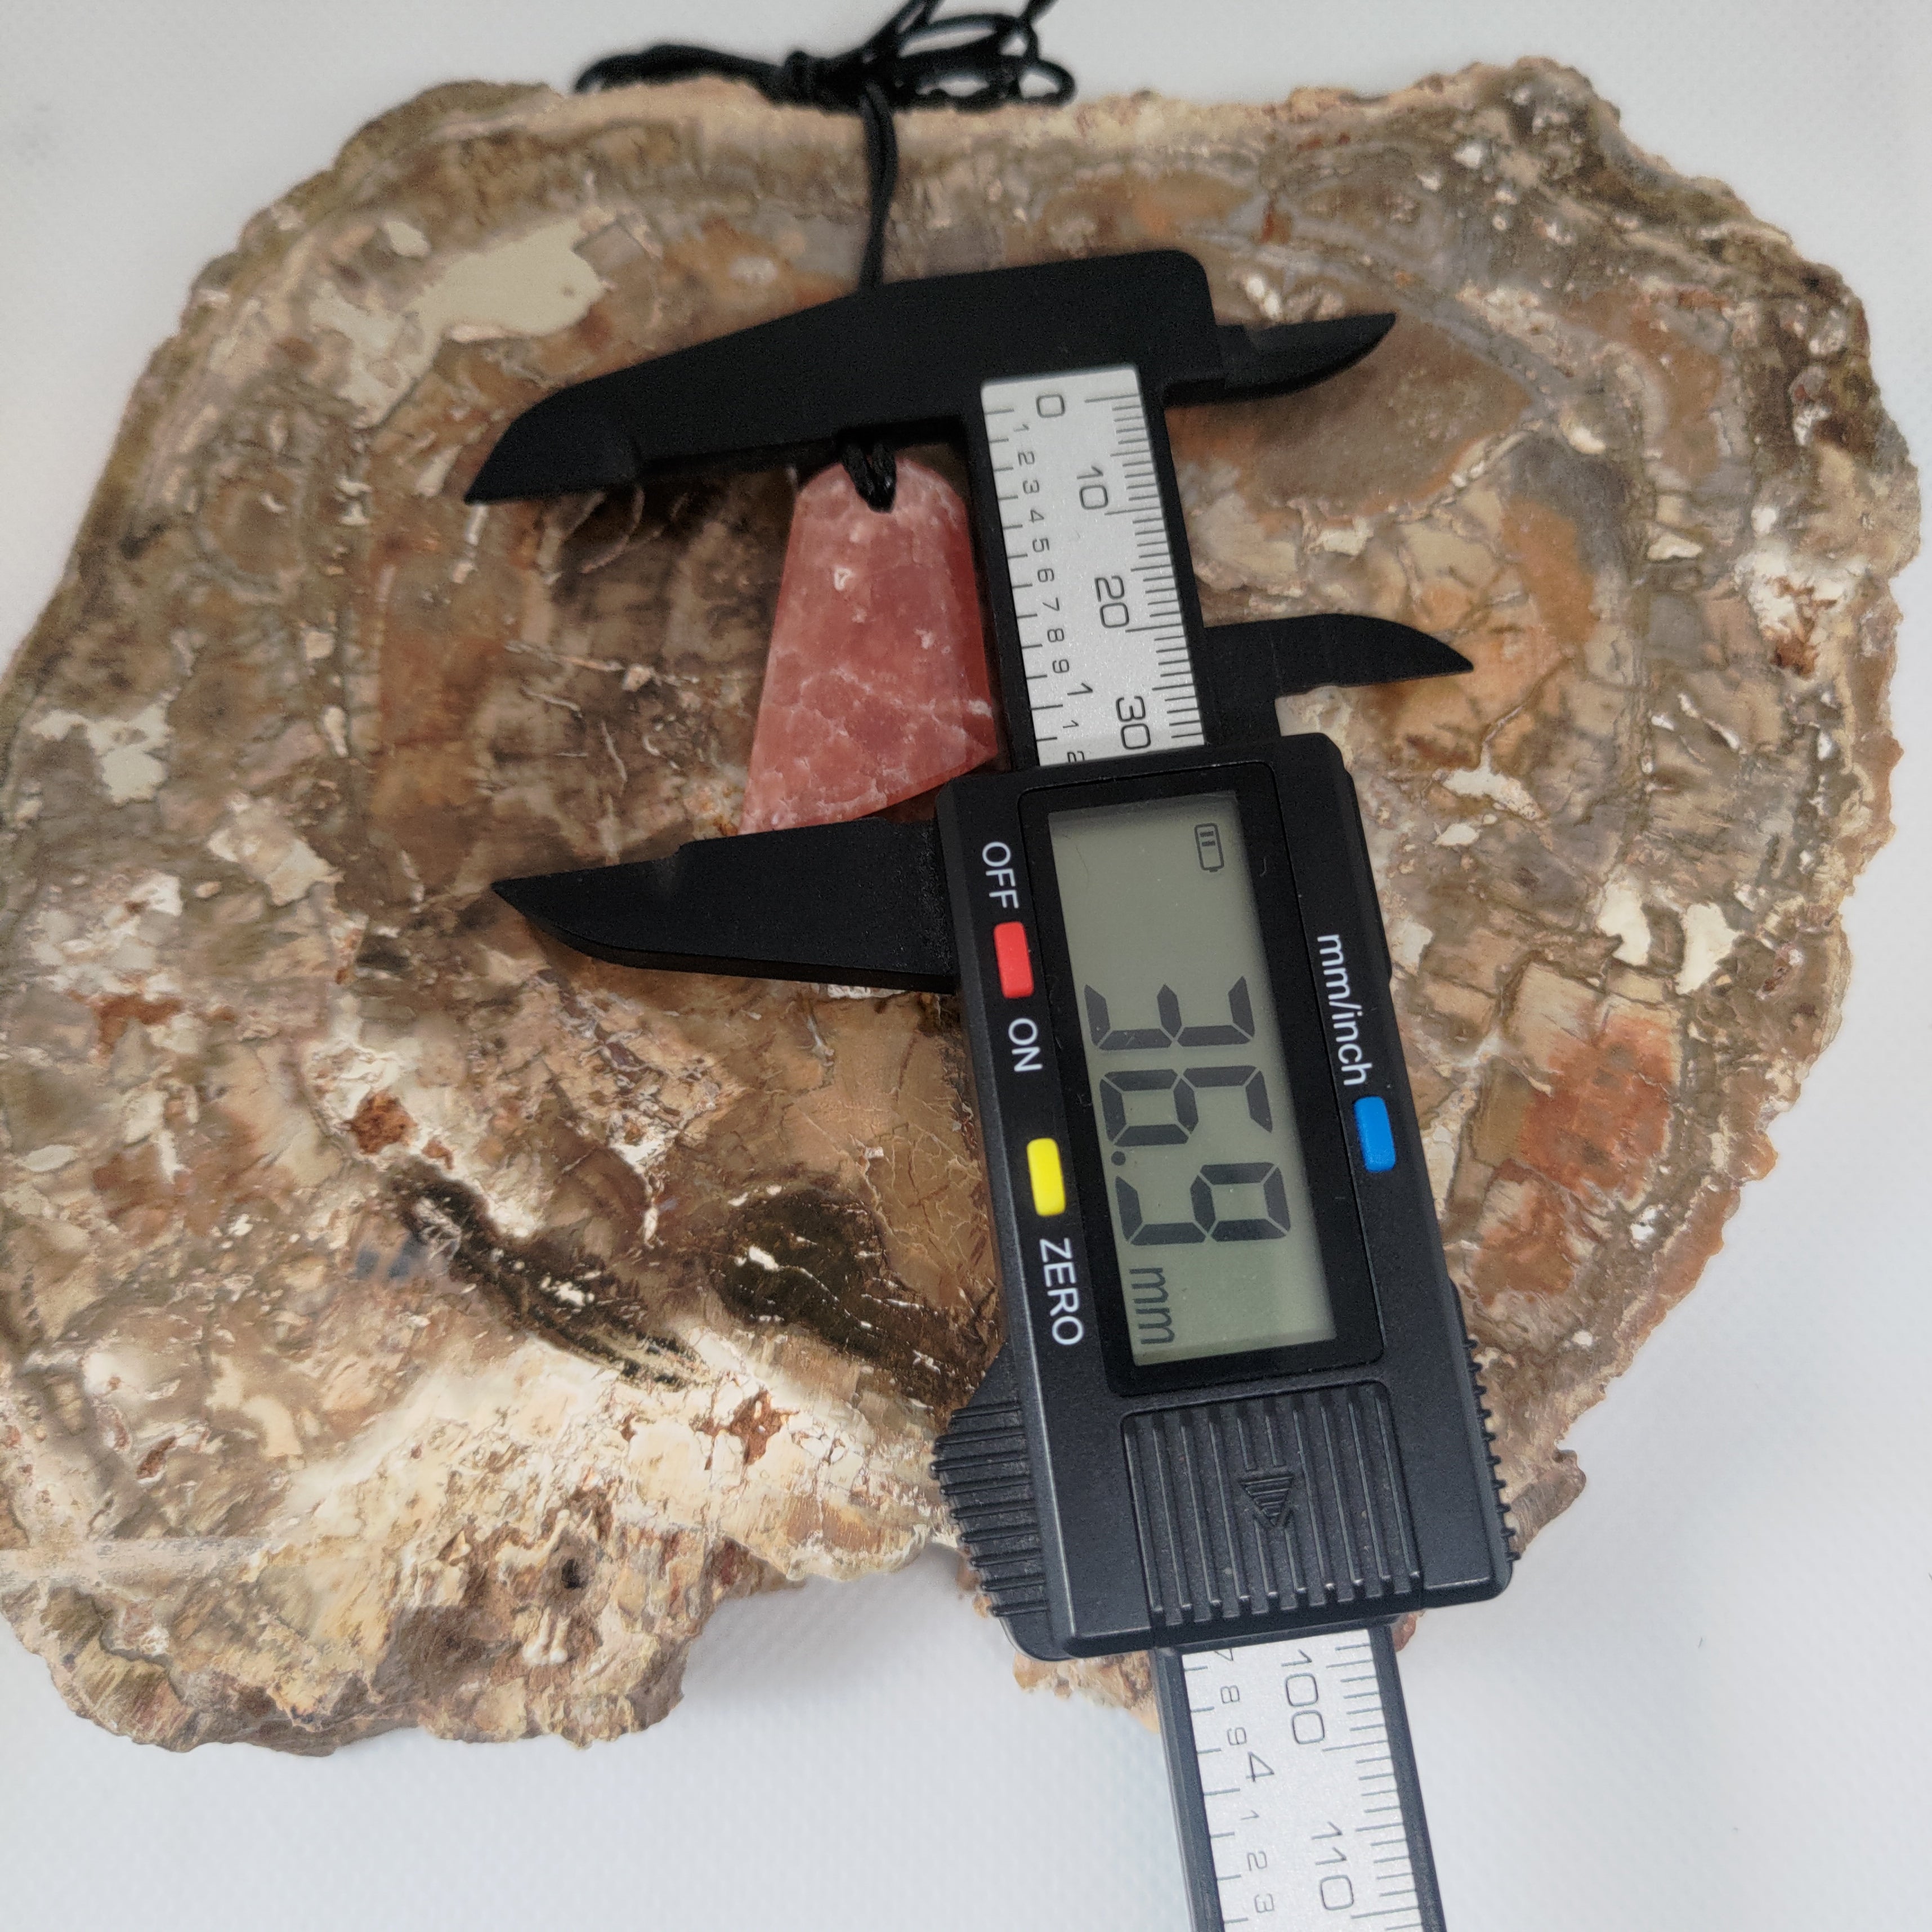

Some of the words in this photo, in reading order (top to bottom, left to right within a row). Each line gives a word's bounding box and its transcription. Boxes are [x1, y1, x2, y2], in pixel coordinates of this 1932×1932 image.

[1014, 423, 1030, 432] 1
[1017, 450, 1035, 466] 2
[1022, 479, 1040, 494] 3
[1028, 508, 1045, 524] 4
[1032, 537, 1050, 553] 5
[1035, 392, 1066, 419] 0
[1076, 465, 1110, 511] 10
[1094, 575, 1130, 629] 20
[1115, 695, 1151, 750] 30
[1037, 567, 1055, 583] 6
[1042, 597, 1060, 612] 7
[1046, 628, 1065, 643] 8
[1052, 658, 1070, 674] 9
[1067, 682, 1094, 696] 1
[1062, 719, 1080, 729] 1
[982, 842, 1019, 909] OFF
[1317, 934, 1372, 1086] mm/inch
[1008, 1018, 1043, 1072] ON
[1084, 976, 1291, 1245] 36.9
[1039, 1237, 1084, 1345] ZERO
[1128, 1267, 1175, 1345] mm
[1220, 1685, 1241, 1705] 8
[1226, 1727, 1247, 1746] 9
[1245, 1751, 1275, 1783] 4
[1281, 1649, 1326, 1745] 100
[1311, 1821, 1355, 1911] 110
[1241, 1810, 1260, 1821] 1
[1246, 1850, 1268, 1872] 2
[1254, 1893, 1275, 1914] 3
